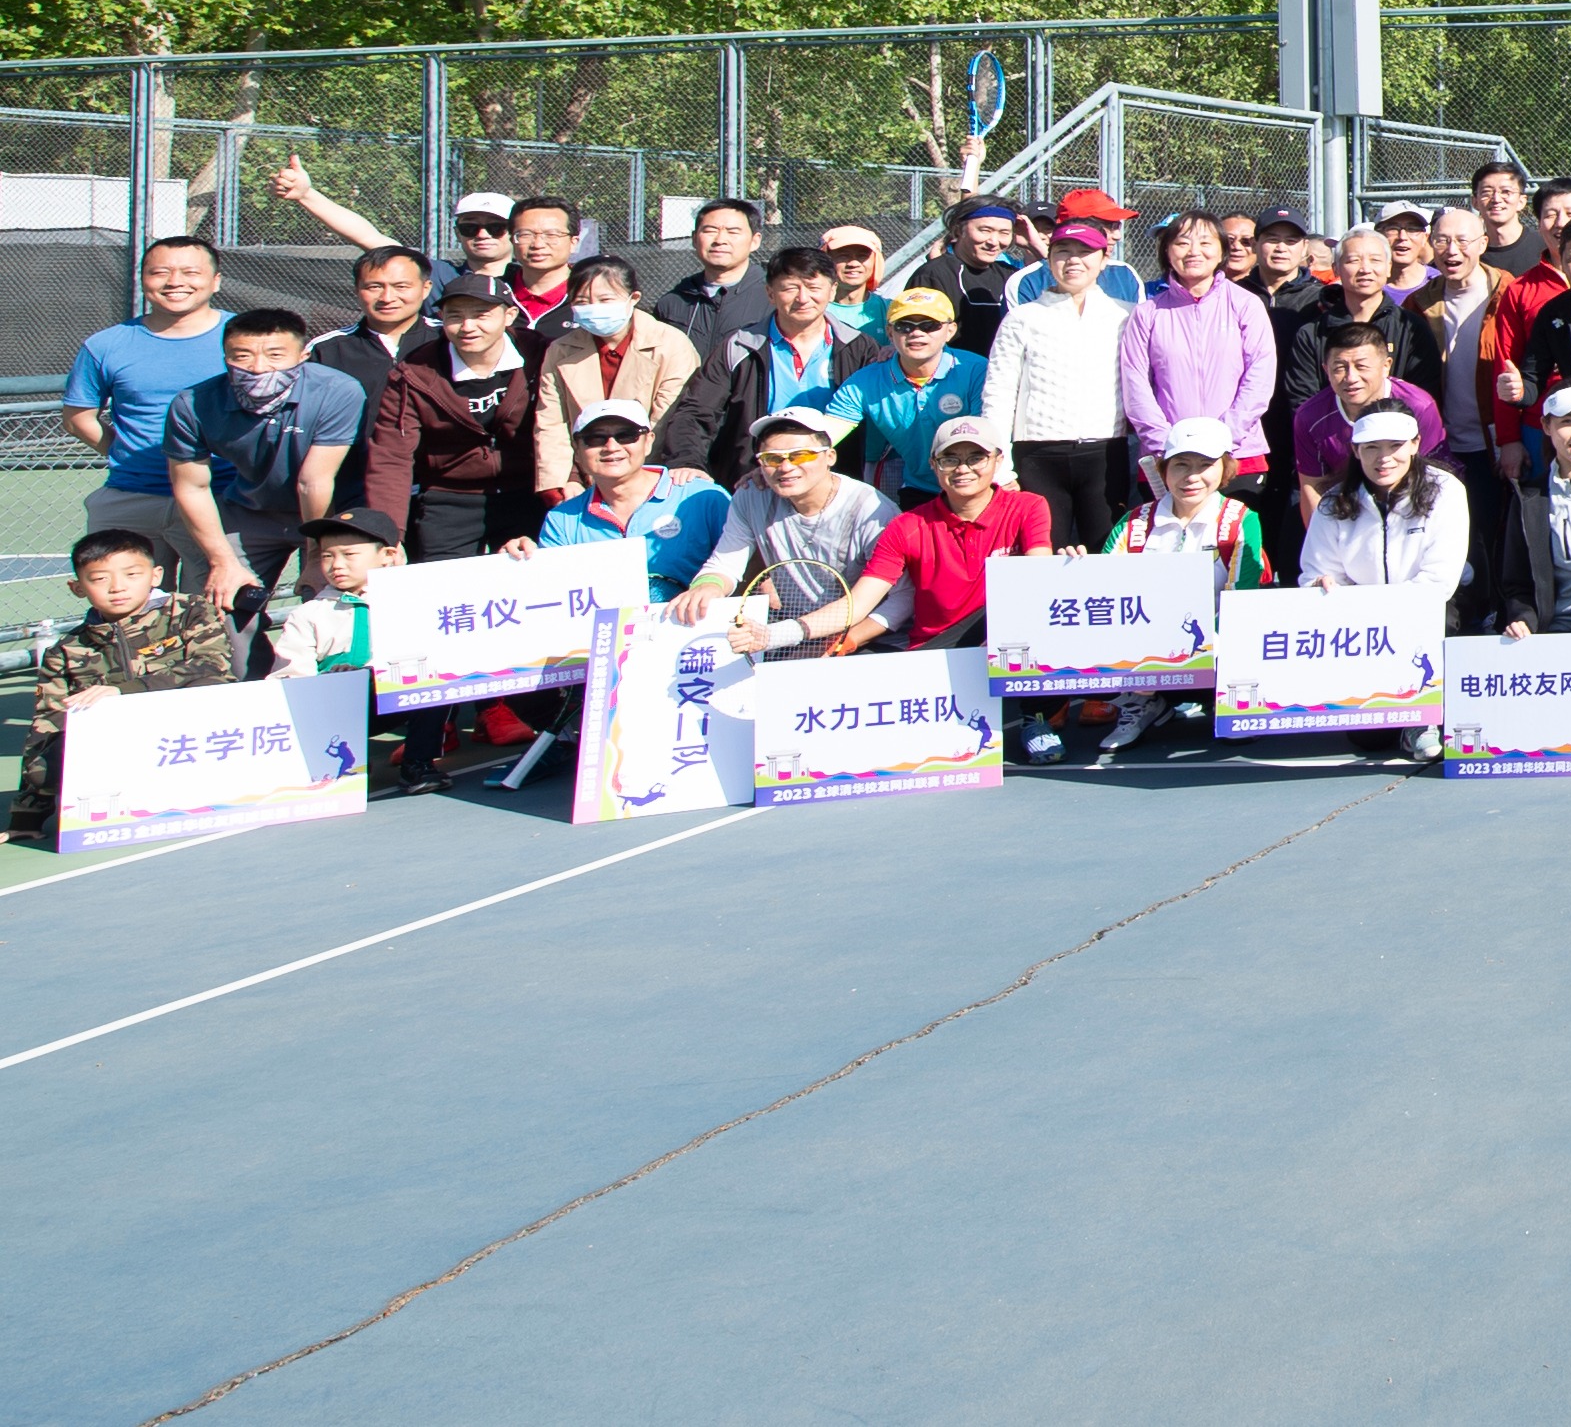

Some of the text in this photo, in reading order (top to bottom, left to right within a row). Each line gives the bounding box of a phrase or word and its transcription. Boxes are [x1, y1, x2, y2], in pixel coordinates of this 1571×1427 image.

[437, 586, 600, 635] 精仪一队
[1048, 594, 1151, 628] 经管队
[1261, 624, 1396, 661] 自动化队
[1005, 672, 1194, 693] 2023 全球清华校友网球联赛 校庆站
[398, 690, 442, 706] 2023
[671, 645, 717, 775] 精仪二队
[794, 693, 964, 734] 水力工联队
[1232, 709, 1421, 731] 2023 全球清华校友网球联赛 校庆站
[157, 722, 293, 767] 法学院
[1458, 761, 1490, 775] 2023
[773, 789, 812, 802] 2023
[83, 828, 131, 845] 2023
